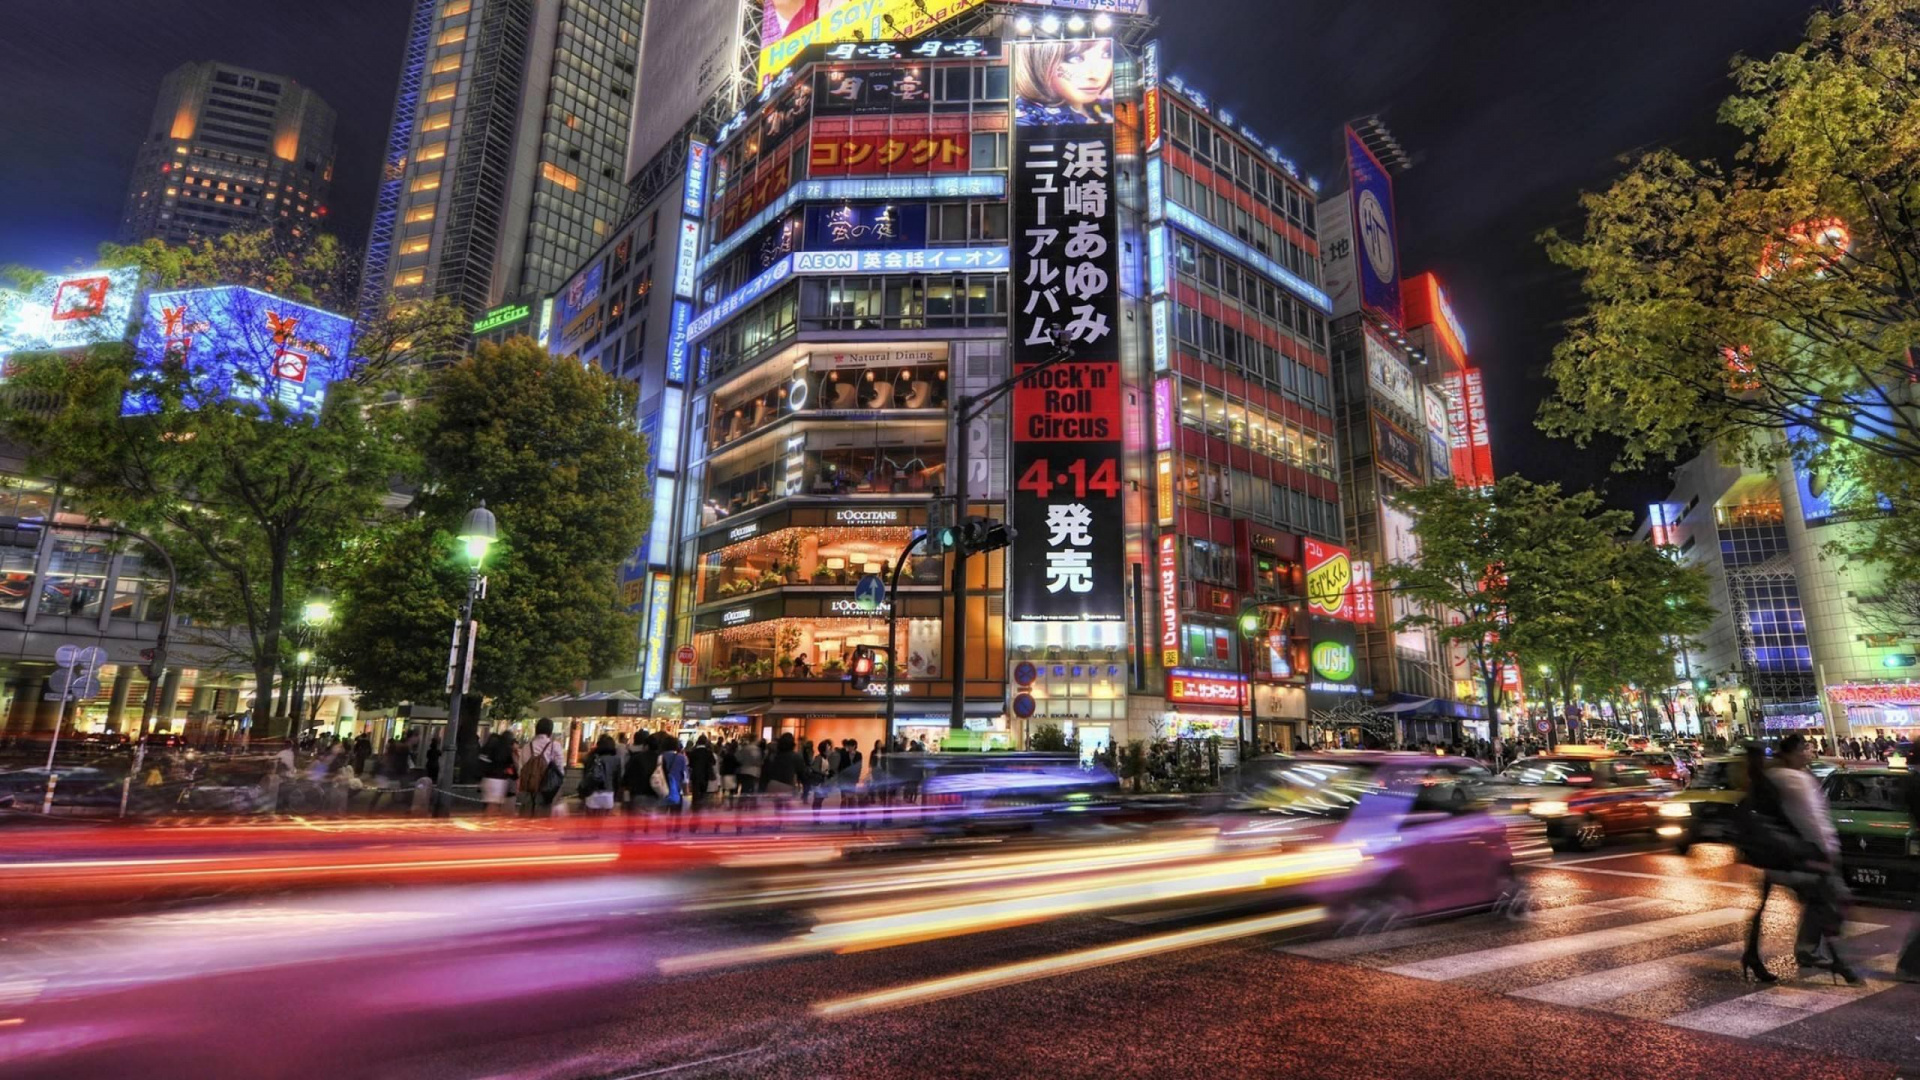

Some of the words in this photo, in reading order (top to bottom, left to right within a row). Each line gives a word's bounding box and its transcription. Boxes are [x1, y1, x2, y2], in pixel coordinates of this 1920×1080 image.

[769, 21, 821, 66] Hey!
[831, 0, 884, 32] Say
[812, 139, 966, 165] コンタクト
[1024, 144, 1060, 346] ニューアルバム
[1062, 140, 1110, 344] 浜崎あゆみ
[800, 255, 851, 269] AEON
[863, 251, 1003, 268] 英会話イーオン
[474, 315, 501, 330] MARK
[503, 306, 529, 320] CITY
[850, 352, 890, 363] Natural
[896, 350, 933, 363] Dining
[1022, 366, 1113, 389] Rock'n'
[1045, 390, 1091, 413] Roll
[1028, 415, 1109, 438] Circus
[837, 510, 897, 520] L'OCCITANE
[1045, 503, 1093, 593] 発売
[1315, 645, 1350, 672] LUSH
